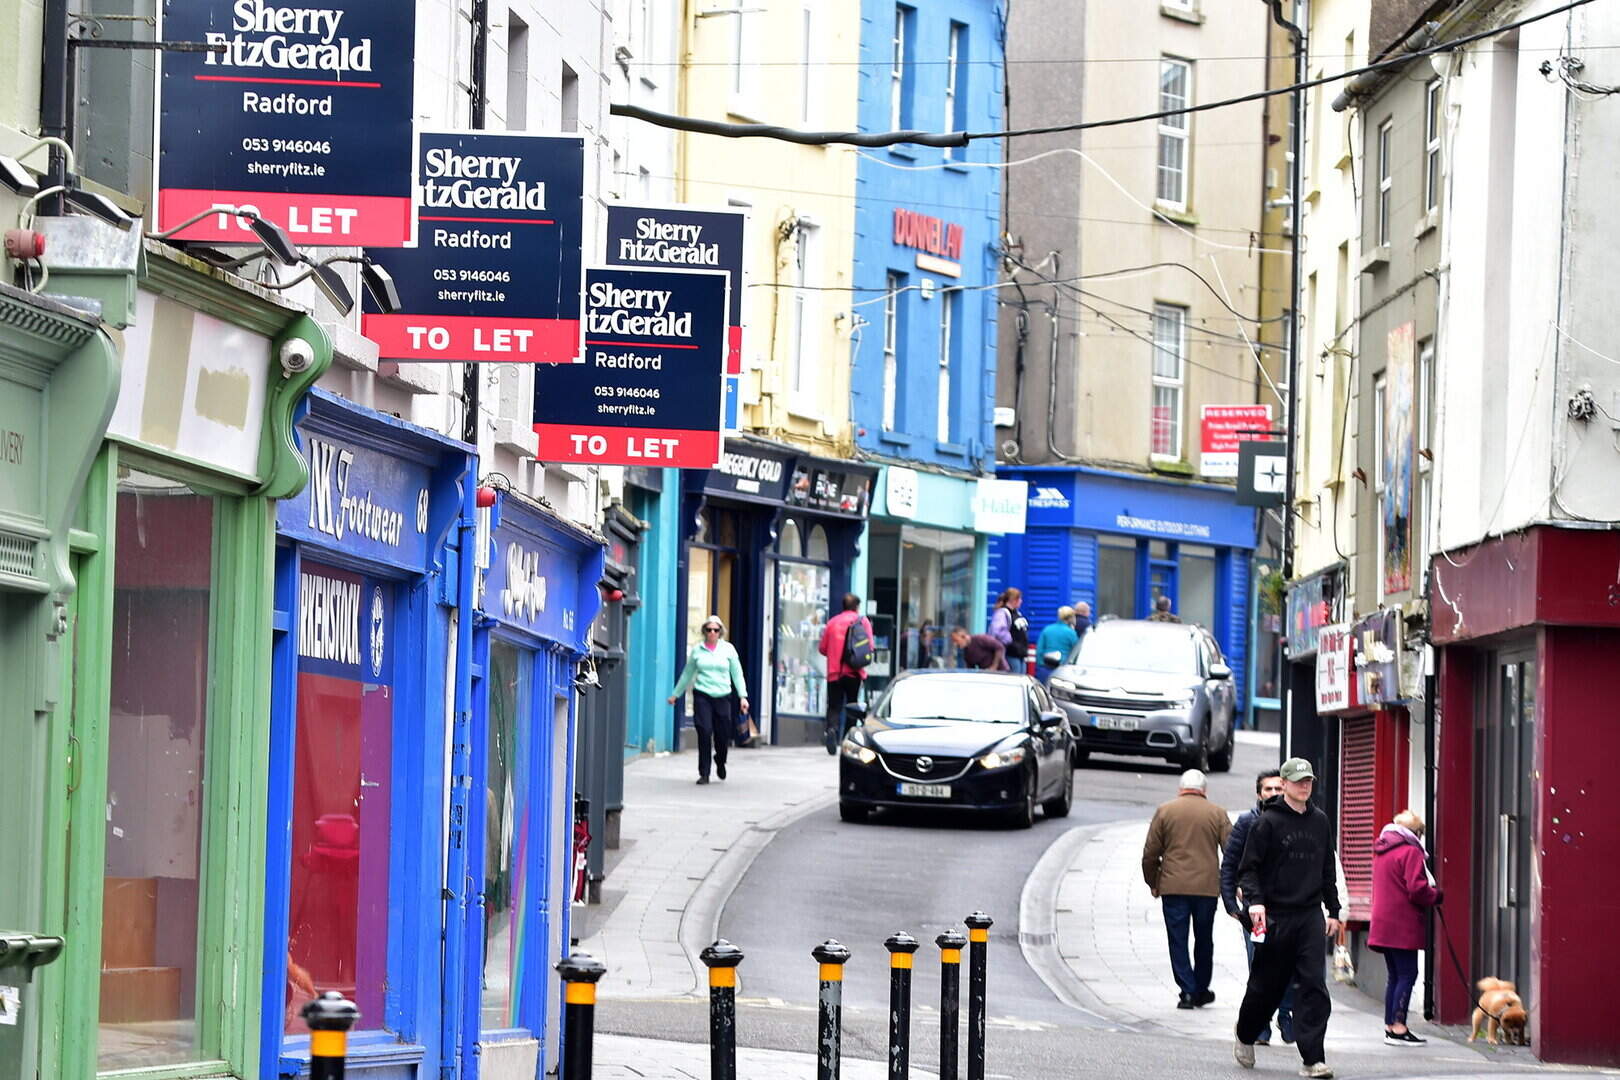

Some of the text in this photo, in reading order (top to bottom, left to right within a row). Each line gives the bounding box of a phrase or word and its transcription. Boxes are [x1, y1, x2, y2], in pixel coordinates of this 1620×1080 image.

[233, 0, 344, 43] Sherry
[204, 31, 372, 73] FitzGerald
[243, 92, 333, 117] Radford
[243, 138, 332, 155] 053 9146046
[247, 161, 325, 178] sherryfitz.ie
[425, 148, 522, 187] Sherry
[419, 179, 546, 210] itzGerald
[211, 203, 358, 235] TO LET
[635, 217, 702, 247] Sherry
[433, 229, 512, 249] Radford
[619, 238, 719, 265] FitzGerald
[433, 269, 511, 283] 053 9146046
[437, 289, 506, 303] sherryfitz.ie
[589, 282, 672, 317] Sherry
[586, 308, 692, 338] tzGerald
[406, 326, 534, 352] TO LET
[595, 352, 662, 371] Radford
[594, 385, 660, 399] 053 9146046
[597, 403, 656, 416] sherryfitz.ie
[570, 434, 679, 459] TO LET
[758, 459, 782, 483] GOLD
[335, 449, 403, 547] Footwear
[416, 488, 429, 535] 68
[298, 572, 361, 665] RKENSTOCK
